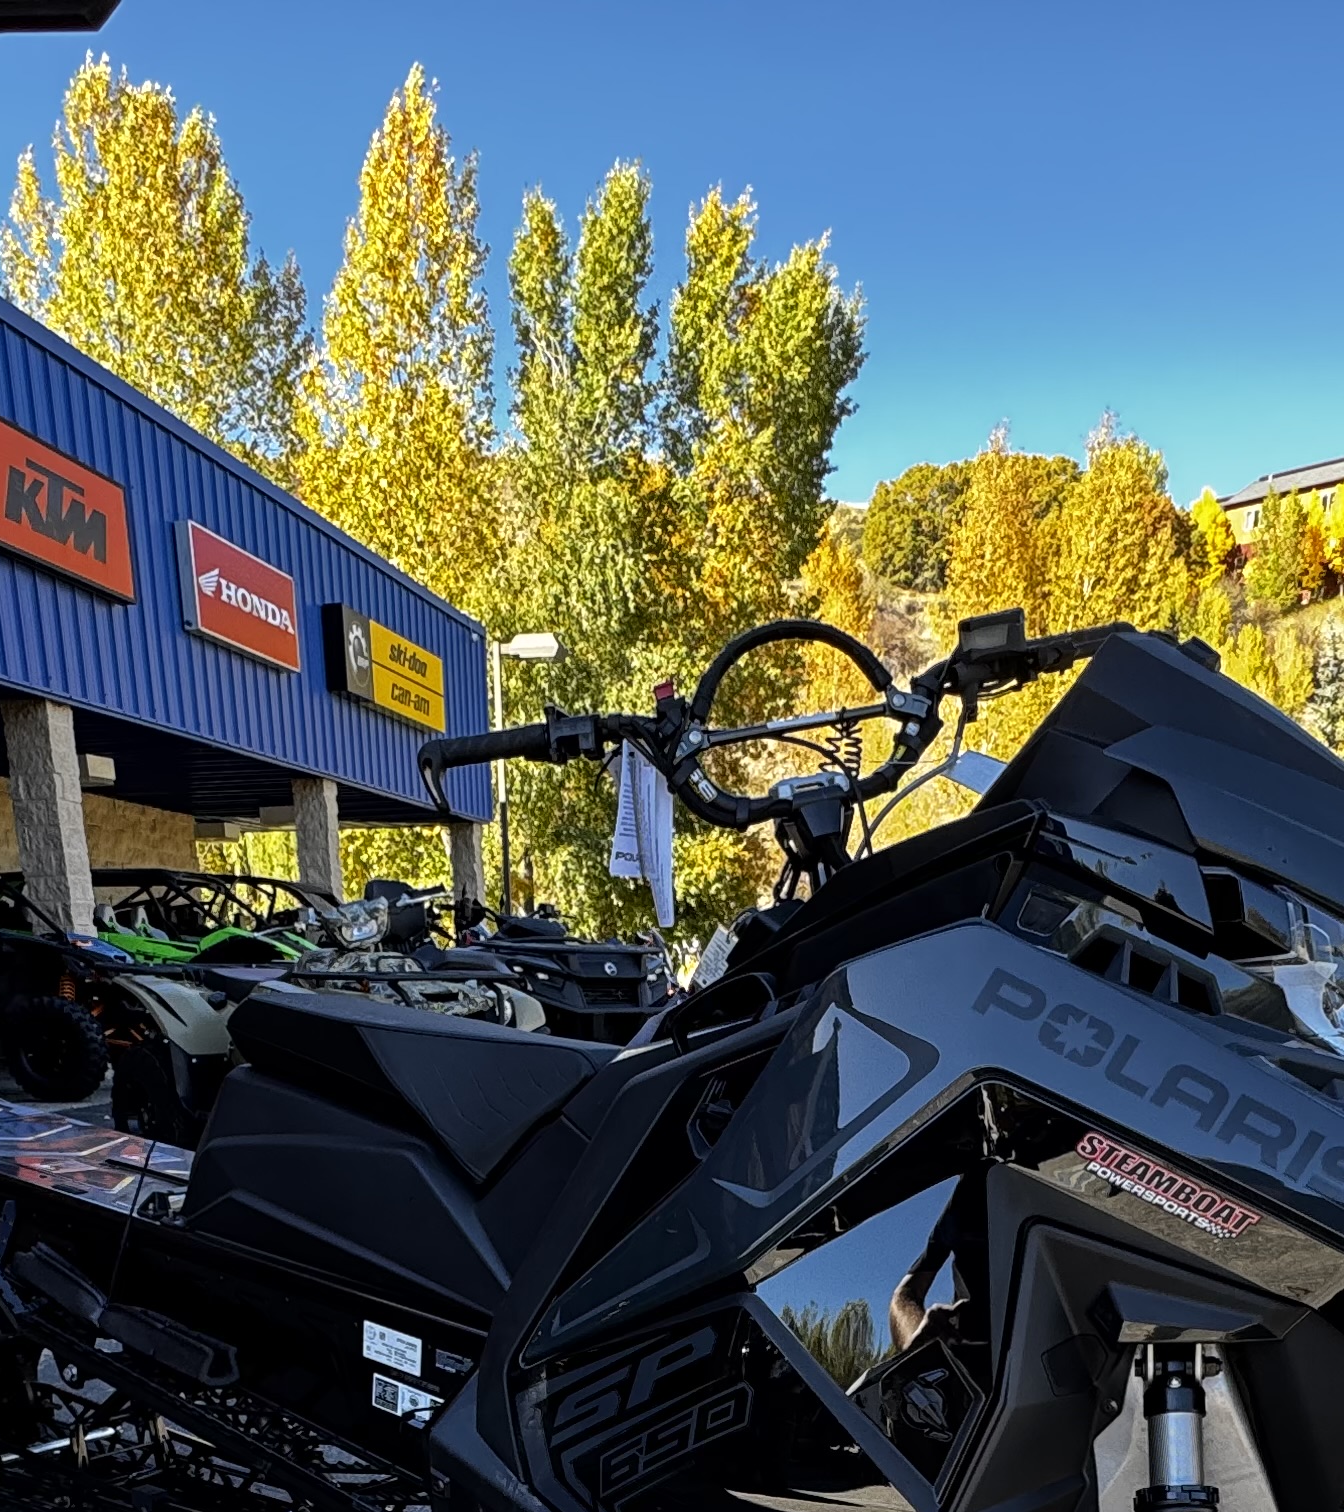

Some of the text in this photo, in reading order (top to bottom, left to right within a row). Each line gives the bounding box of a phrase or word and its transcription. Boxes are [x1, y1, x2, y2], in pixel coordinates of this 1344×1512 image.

[4, 457, 107, 565] KTM
[219, 577, 295, 635] HONDA
[388, 643, 428, 678] ski-doo
[390, 683, 430, 717] can-am
[1077, 1131, 1262, 1237] STEAMBOAT
[1086, 1161, 1210, 1230] POWERSPORTS
[549, 1326, 717, 1448] SP
[600, 1380, 754, 1498] 650
